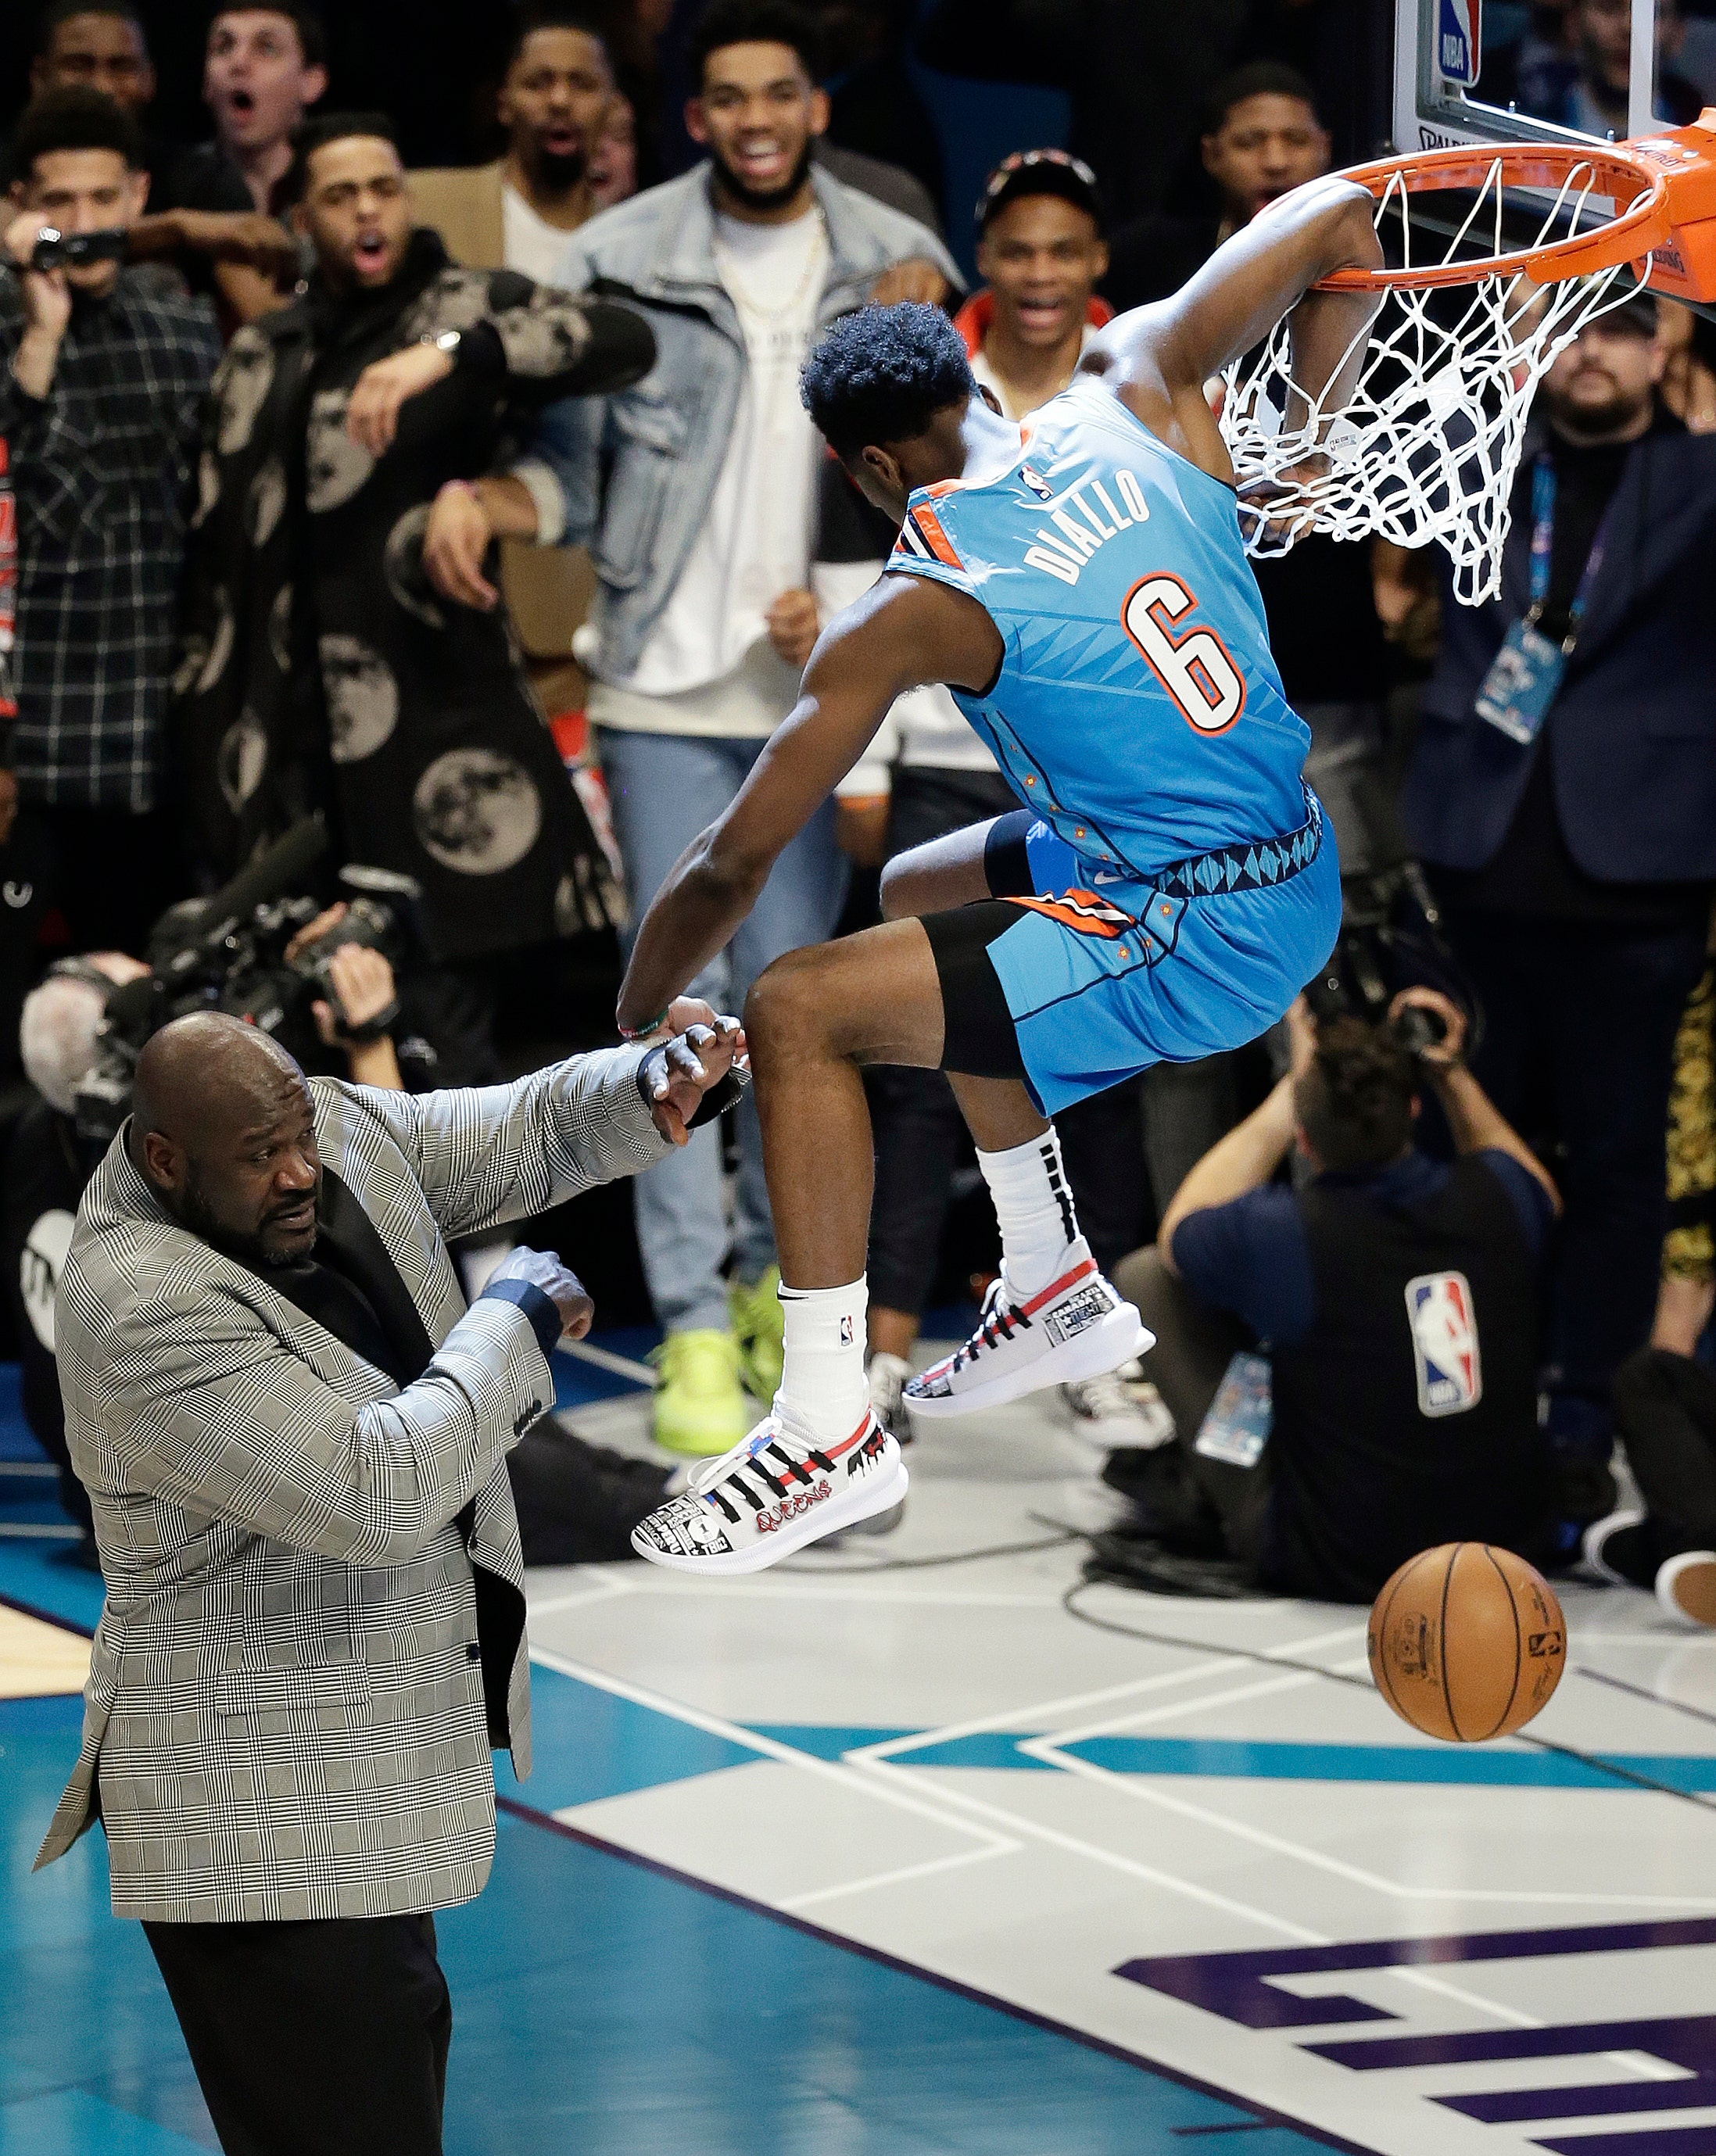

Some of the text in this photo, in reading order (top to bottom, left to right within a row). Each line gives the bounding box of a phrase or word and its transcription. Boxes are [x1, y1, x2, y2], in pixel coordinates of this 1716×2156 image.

[1442, 33, 1464, 71] NBA
[1023, 469, 1150, 586] DIALLO
[1120, 571, 1247, 737] 6
[756, 1479, 833, 1532] QUEENS
[657, 1524, 682, 1554] PERU
